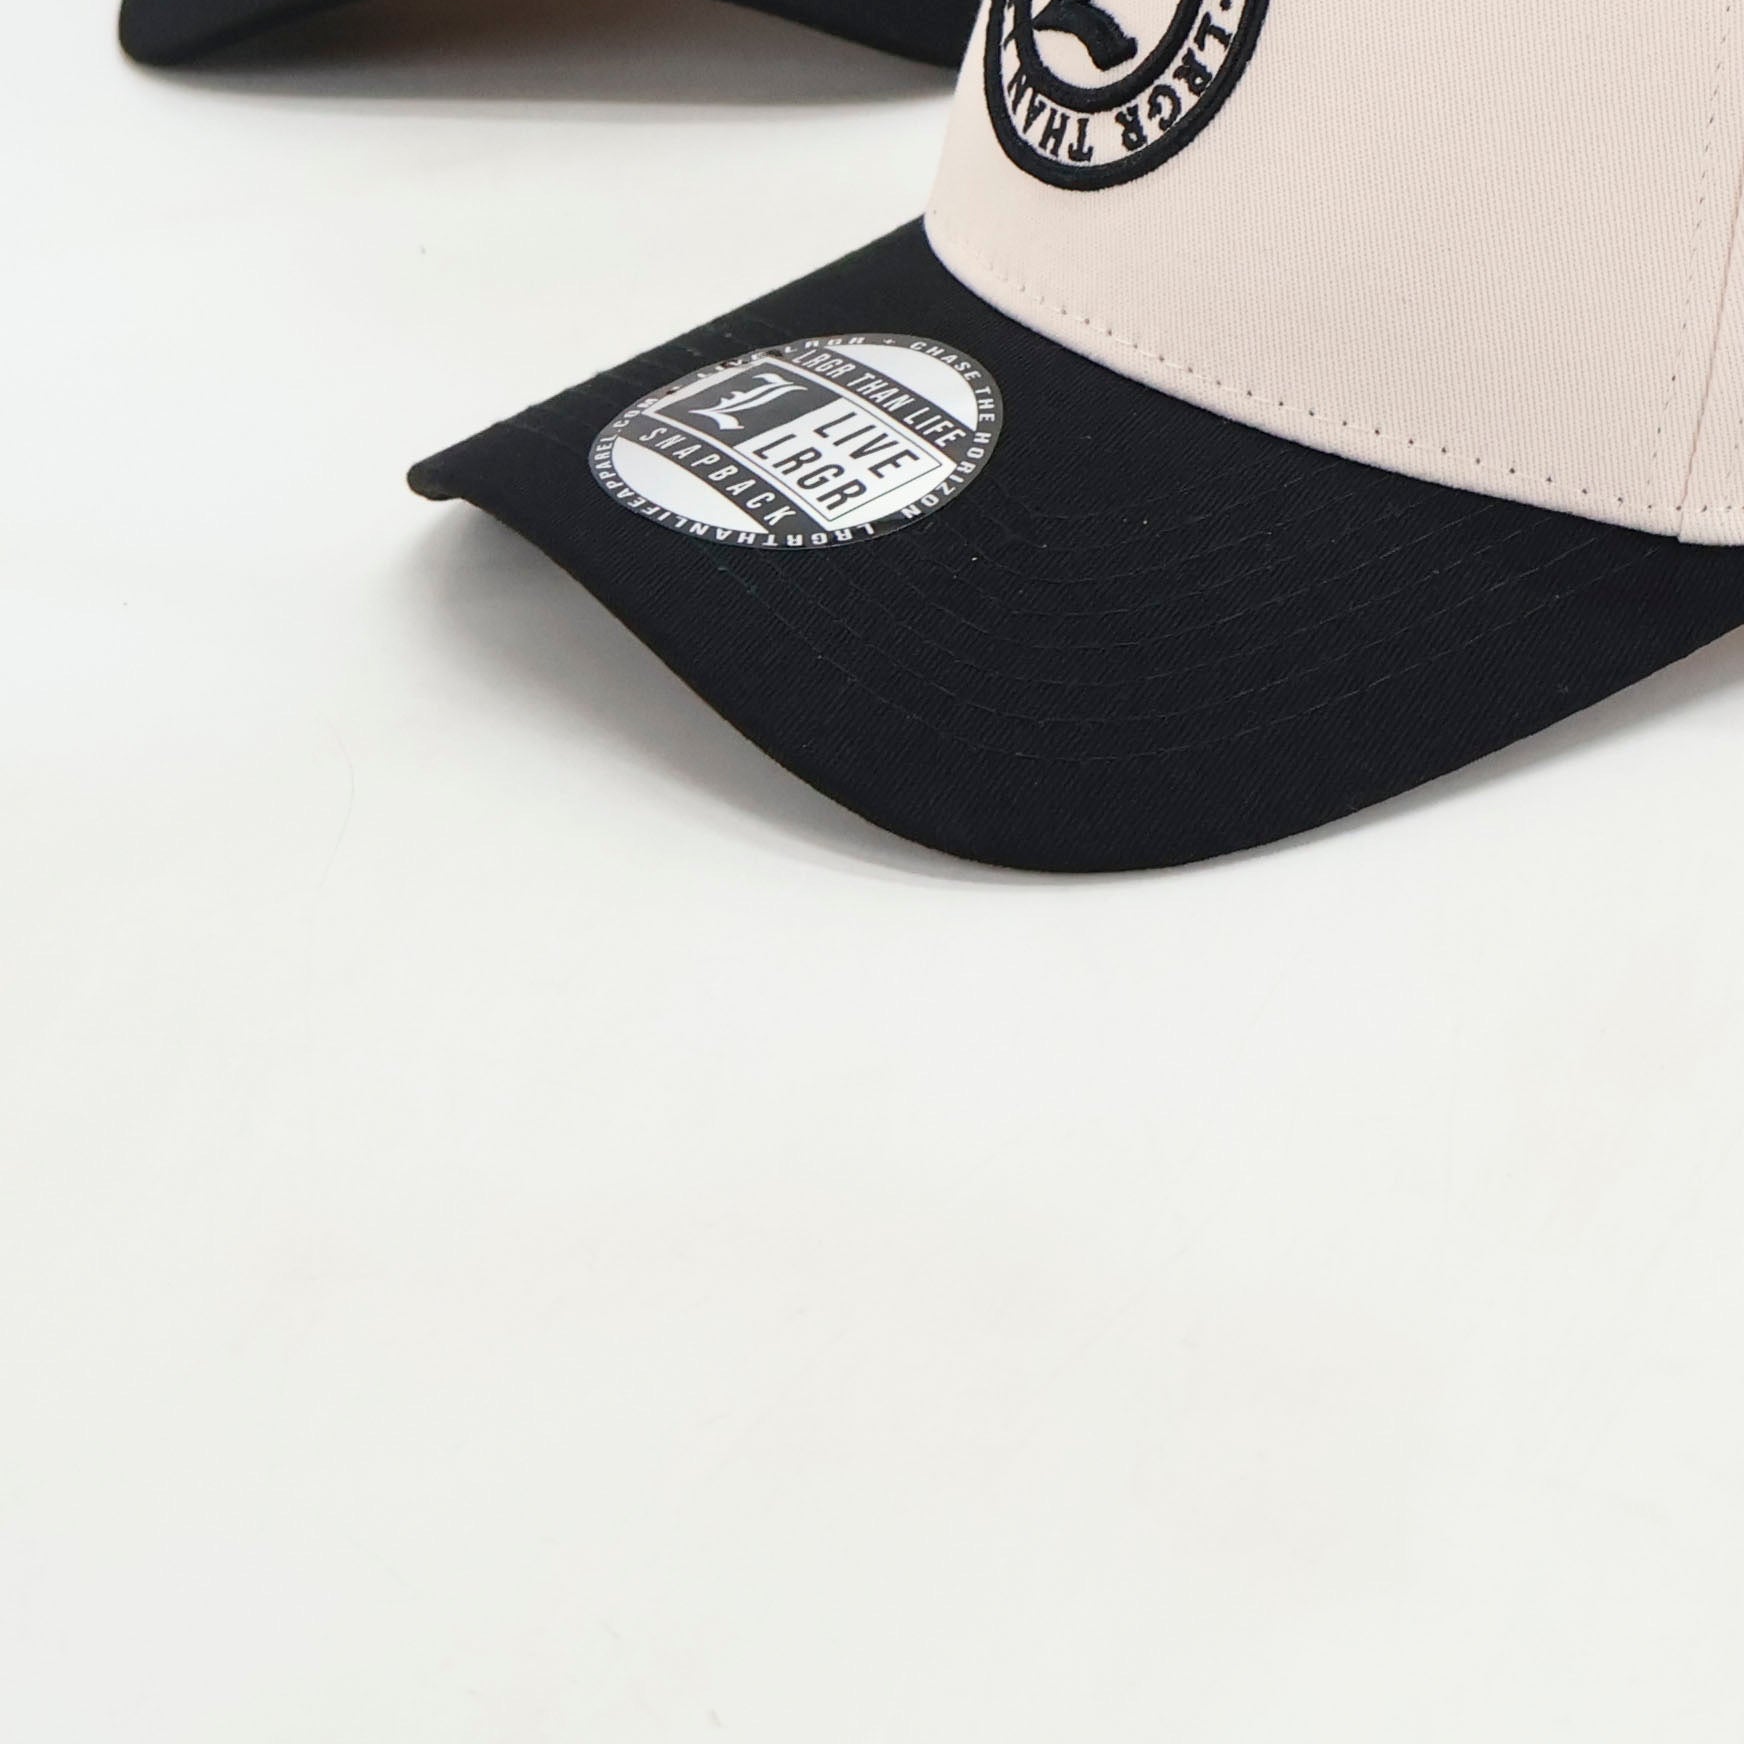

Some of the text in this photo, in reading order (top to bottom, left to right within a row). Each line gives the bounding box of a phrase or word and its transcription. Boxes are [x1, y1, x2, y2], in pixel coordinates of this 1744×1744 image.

[1115, 11, 1233, 152] LRGR
[791, 349, 967, 448] LRGR THAN LIFE
[909, 341, 982, 381] CHASE
[687, 373, 808, 431] L
[975, 385, 996, 422] THE
[639, 427, 796, 526] SNAPBACK
[753, 433, 868, 511] LRGR
[814, 411, 920, 479] LIVE
[901, 431, 992, 520] HORIZON
